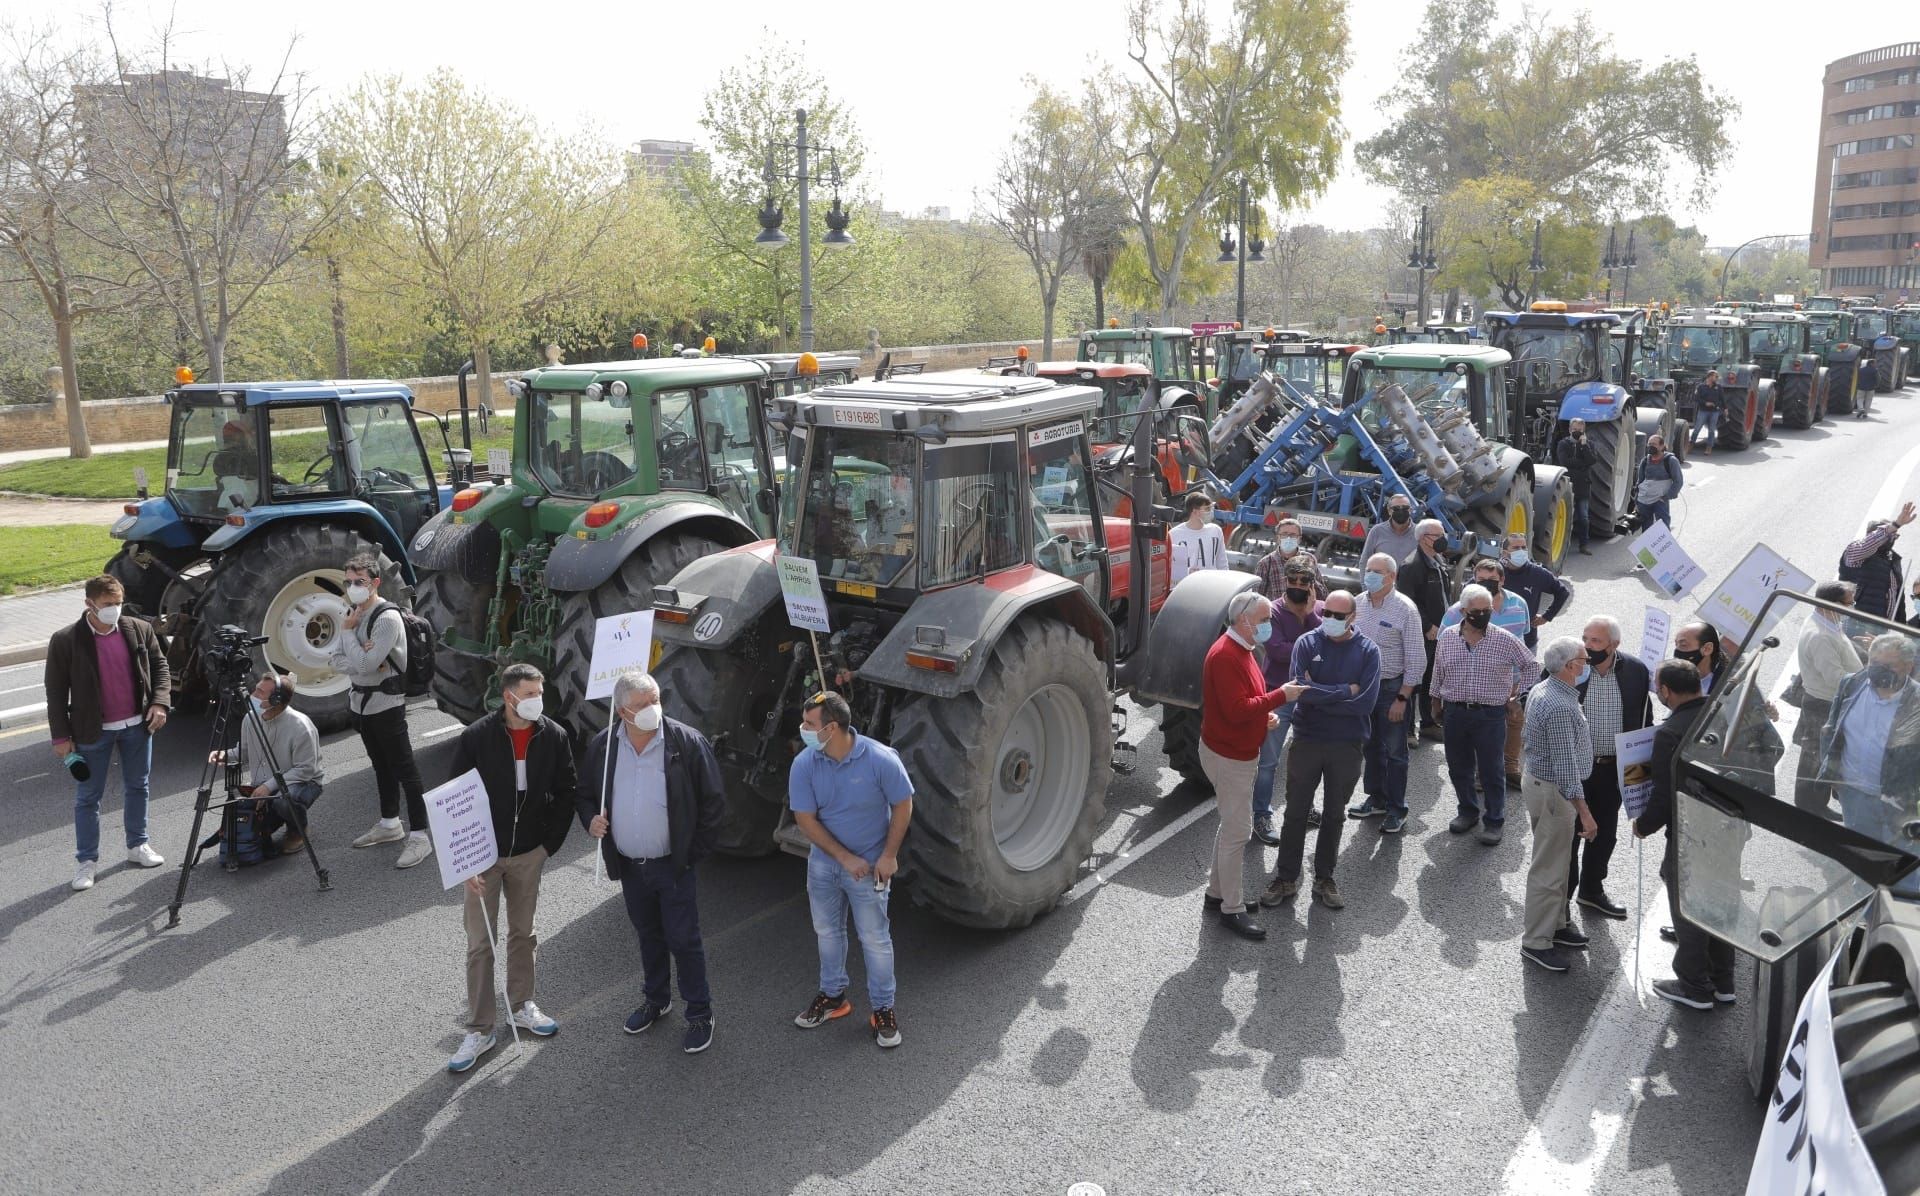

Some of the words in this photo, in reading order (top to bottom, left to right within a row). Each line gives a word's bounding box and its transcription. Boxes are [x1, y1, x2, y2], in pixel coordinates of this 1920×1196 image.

[1044, 423, 1080, 440] AGROTURIA
[784, 563, 808, 574] SALVEM
[792, 603, 817, 613] SALVEM
[695, 615, 721, 638] 40
[594, 671, 607, 681] LA
[436, 798, 444, 808] Ni
[456, 794, 475, 807] nostre
[452, 830, 460, 838] Ni
[460, 820, 480, 834] ajudes
[448, 834, 470, 849] dignes
[469, 851, 492, 869] societat
